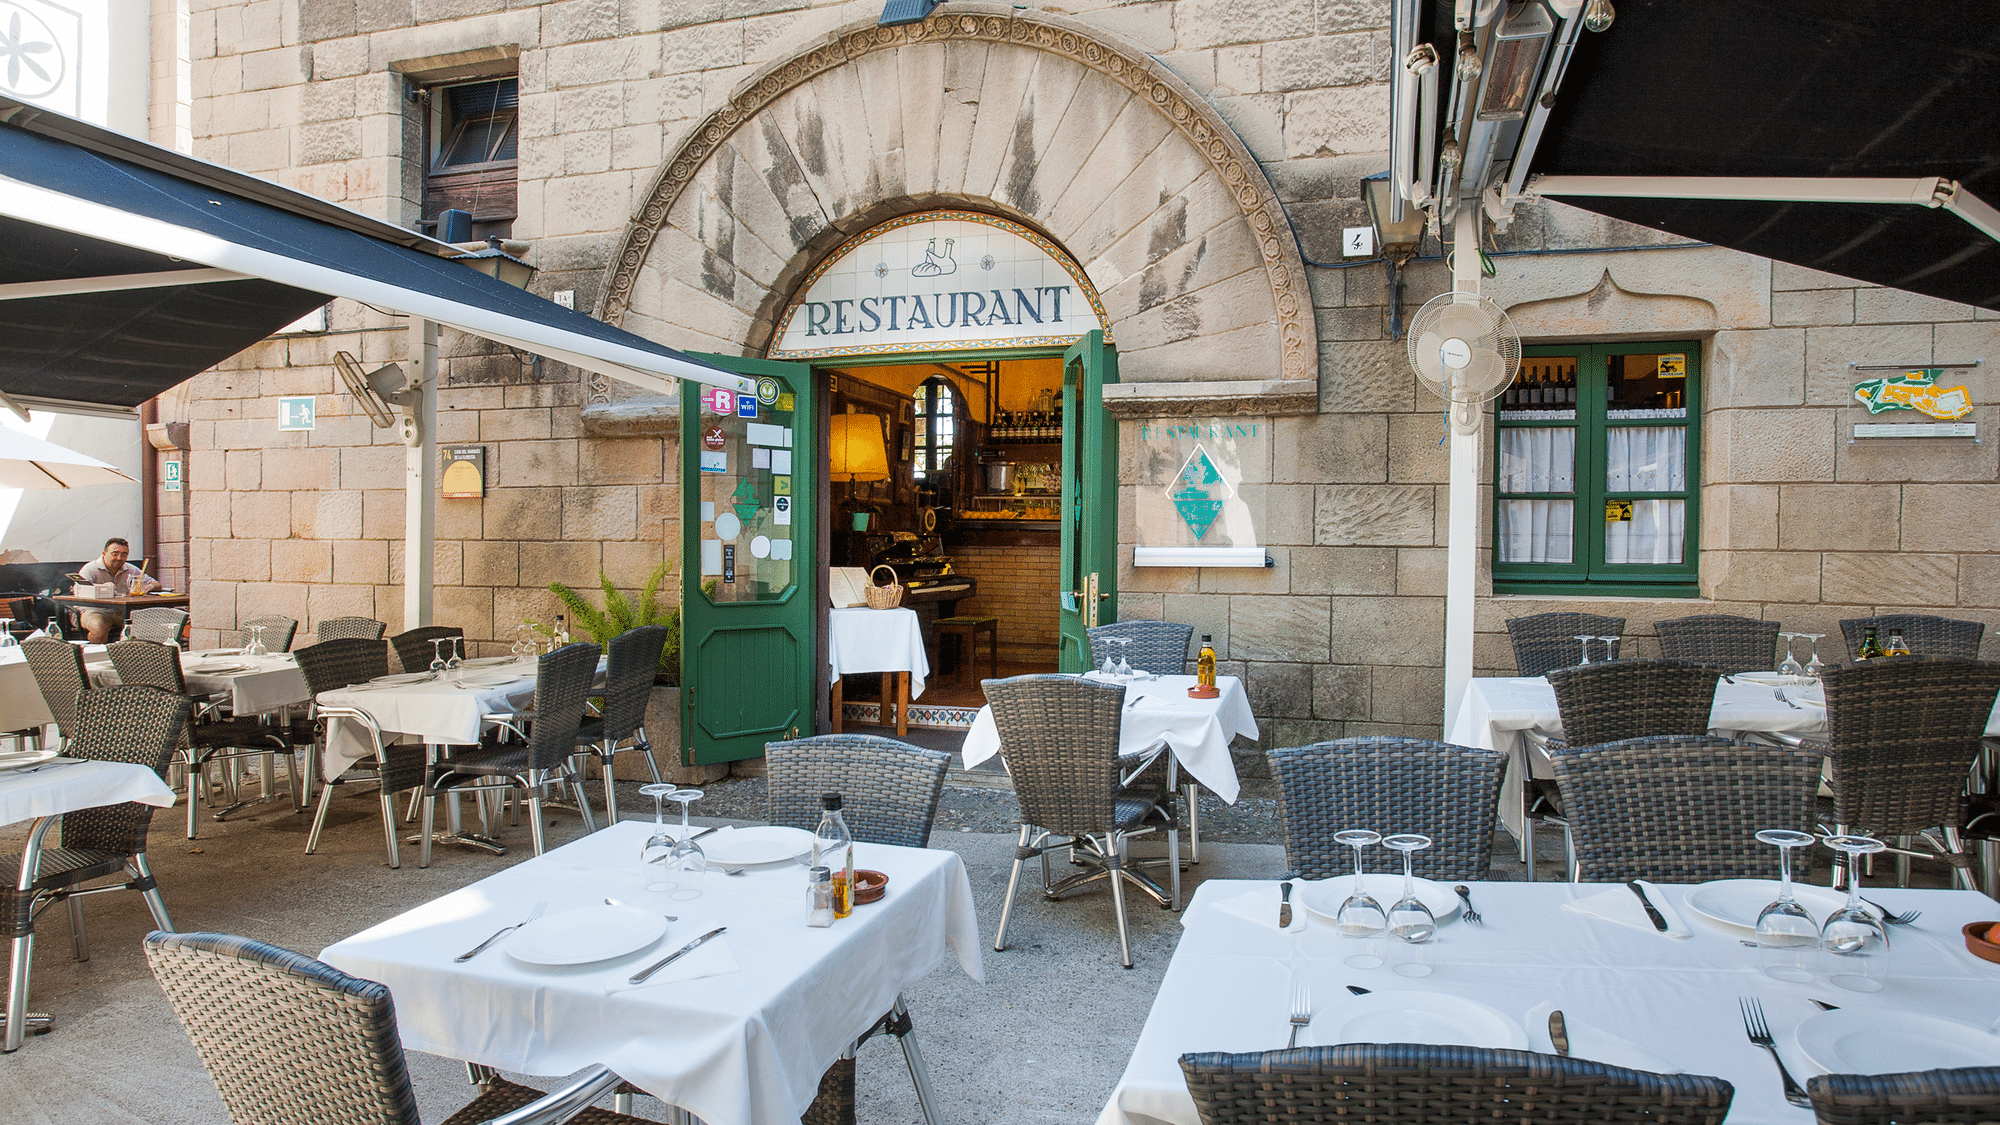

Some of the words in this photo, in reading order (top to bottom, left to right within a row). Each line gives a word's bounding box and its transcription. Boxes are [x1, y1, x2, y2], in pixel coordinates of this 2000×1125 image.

[1508, 20, 1541, 29] EUROWAVE
[805, 285, 1070, 337] RESTAURANT
[1142, 424, 1260, 440] RESTAURANT
[442, 449, 452, 461] 74
